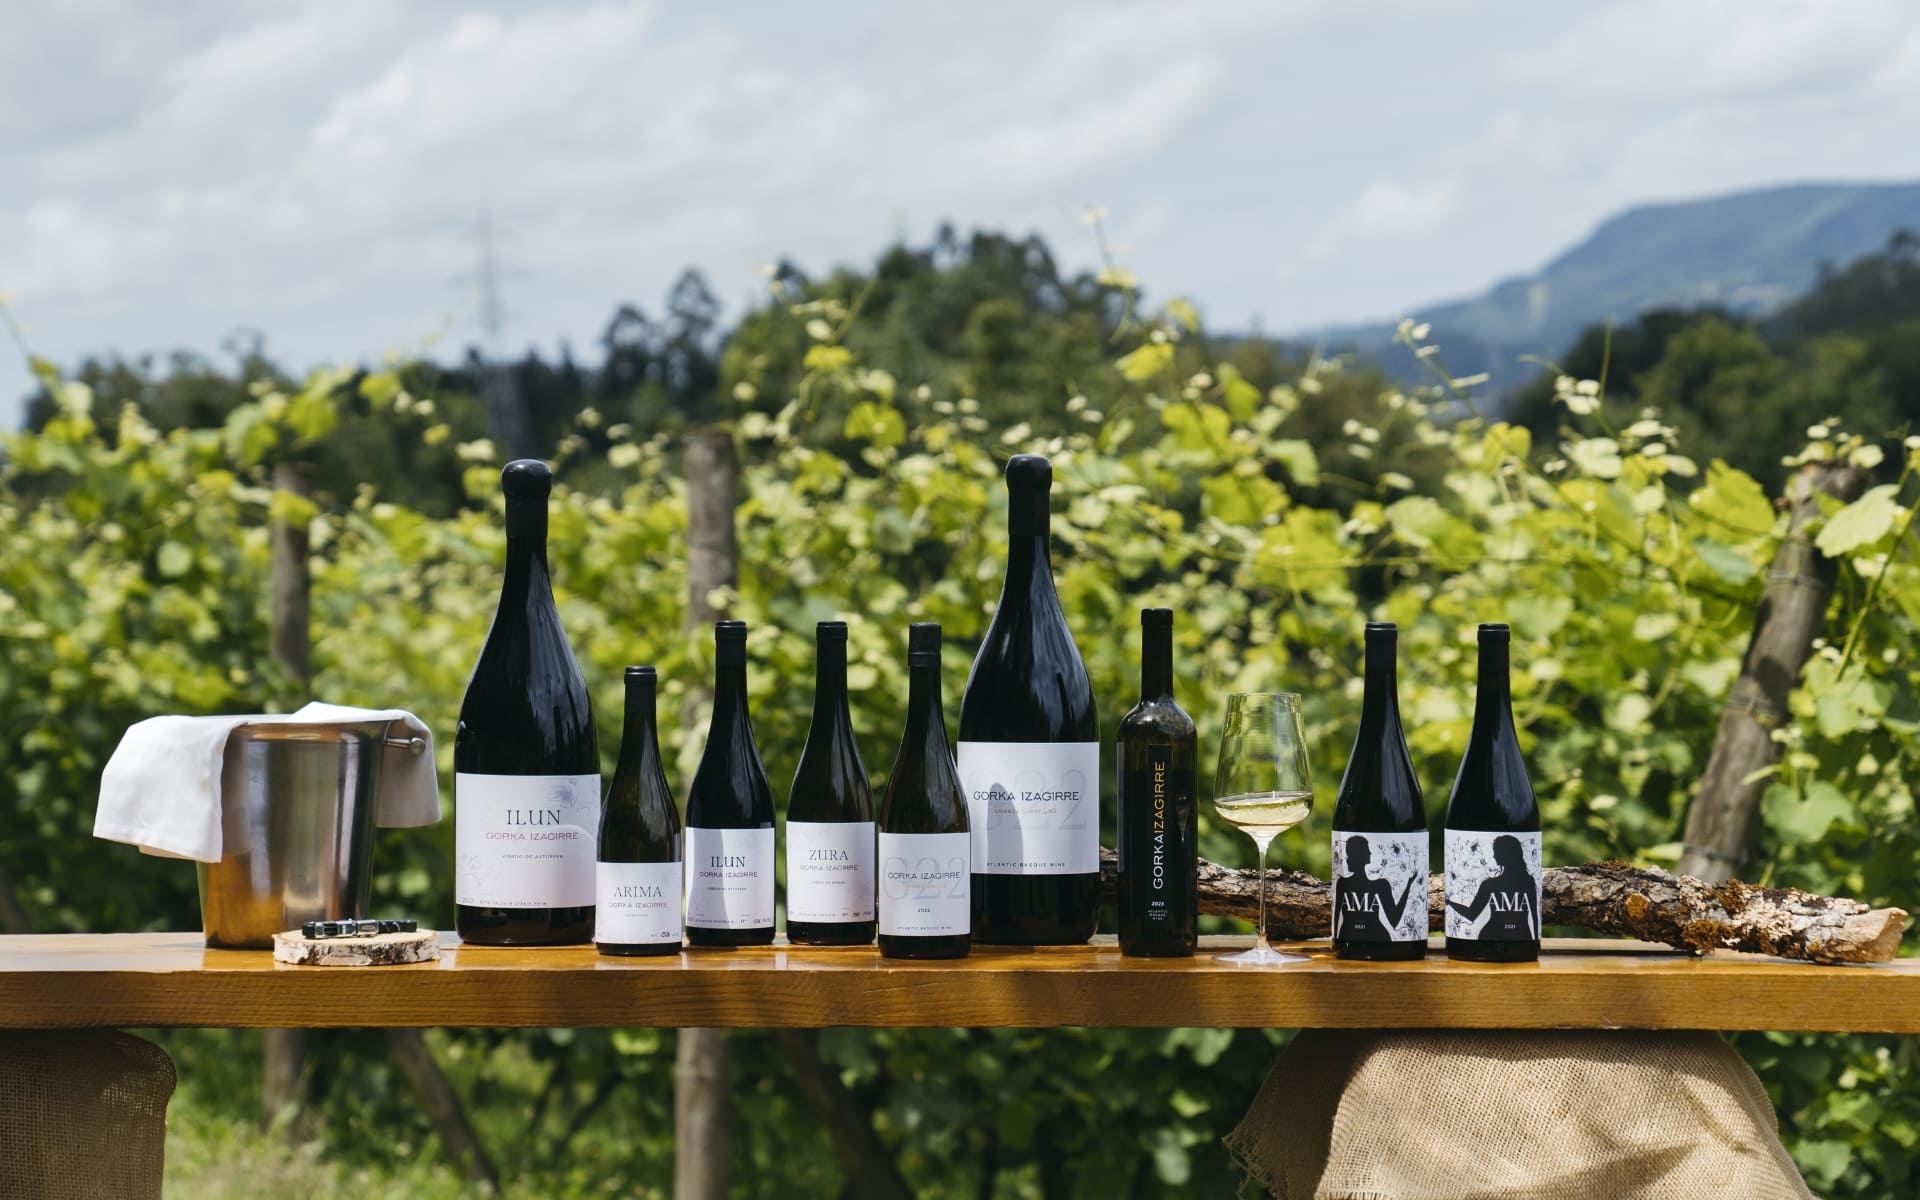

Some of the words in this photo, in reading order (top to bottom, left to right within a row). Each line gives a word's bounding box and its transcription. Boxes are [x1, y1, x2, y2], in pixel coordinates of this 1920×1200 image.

[973, 790, 1017, 801] GORKA
[1021, 791, 1080, 802] IZAGIRRE
[506, 809, 561, 825] ILUN
[485, 832, 526, 841] GORKA
[530, 832, 579, 841] IZAGIRRE
[809, 849, 849, 861] ZURA
[710, 855, 746, 868] ILUN
[888, 872, 917, 880] GORKA
[921, 872, 961, 880] IZAGIRRE
[614, 886, 663, 898] ARIMA
[1340, 892, 1380, 912] AMA
[1488, 892, 1530, 912] AMA
